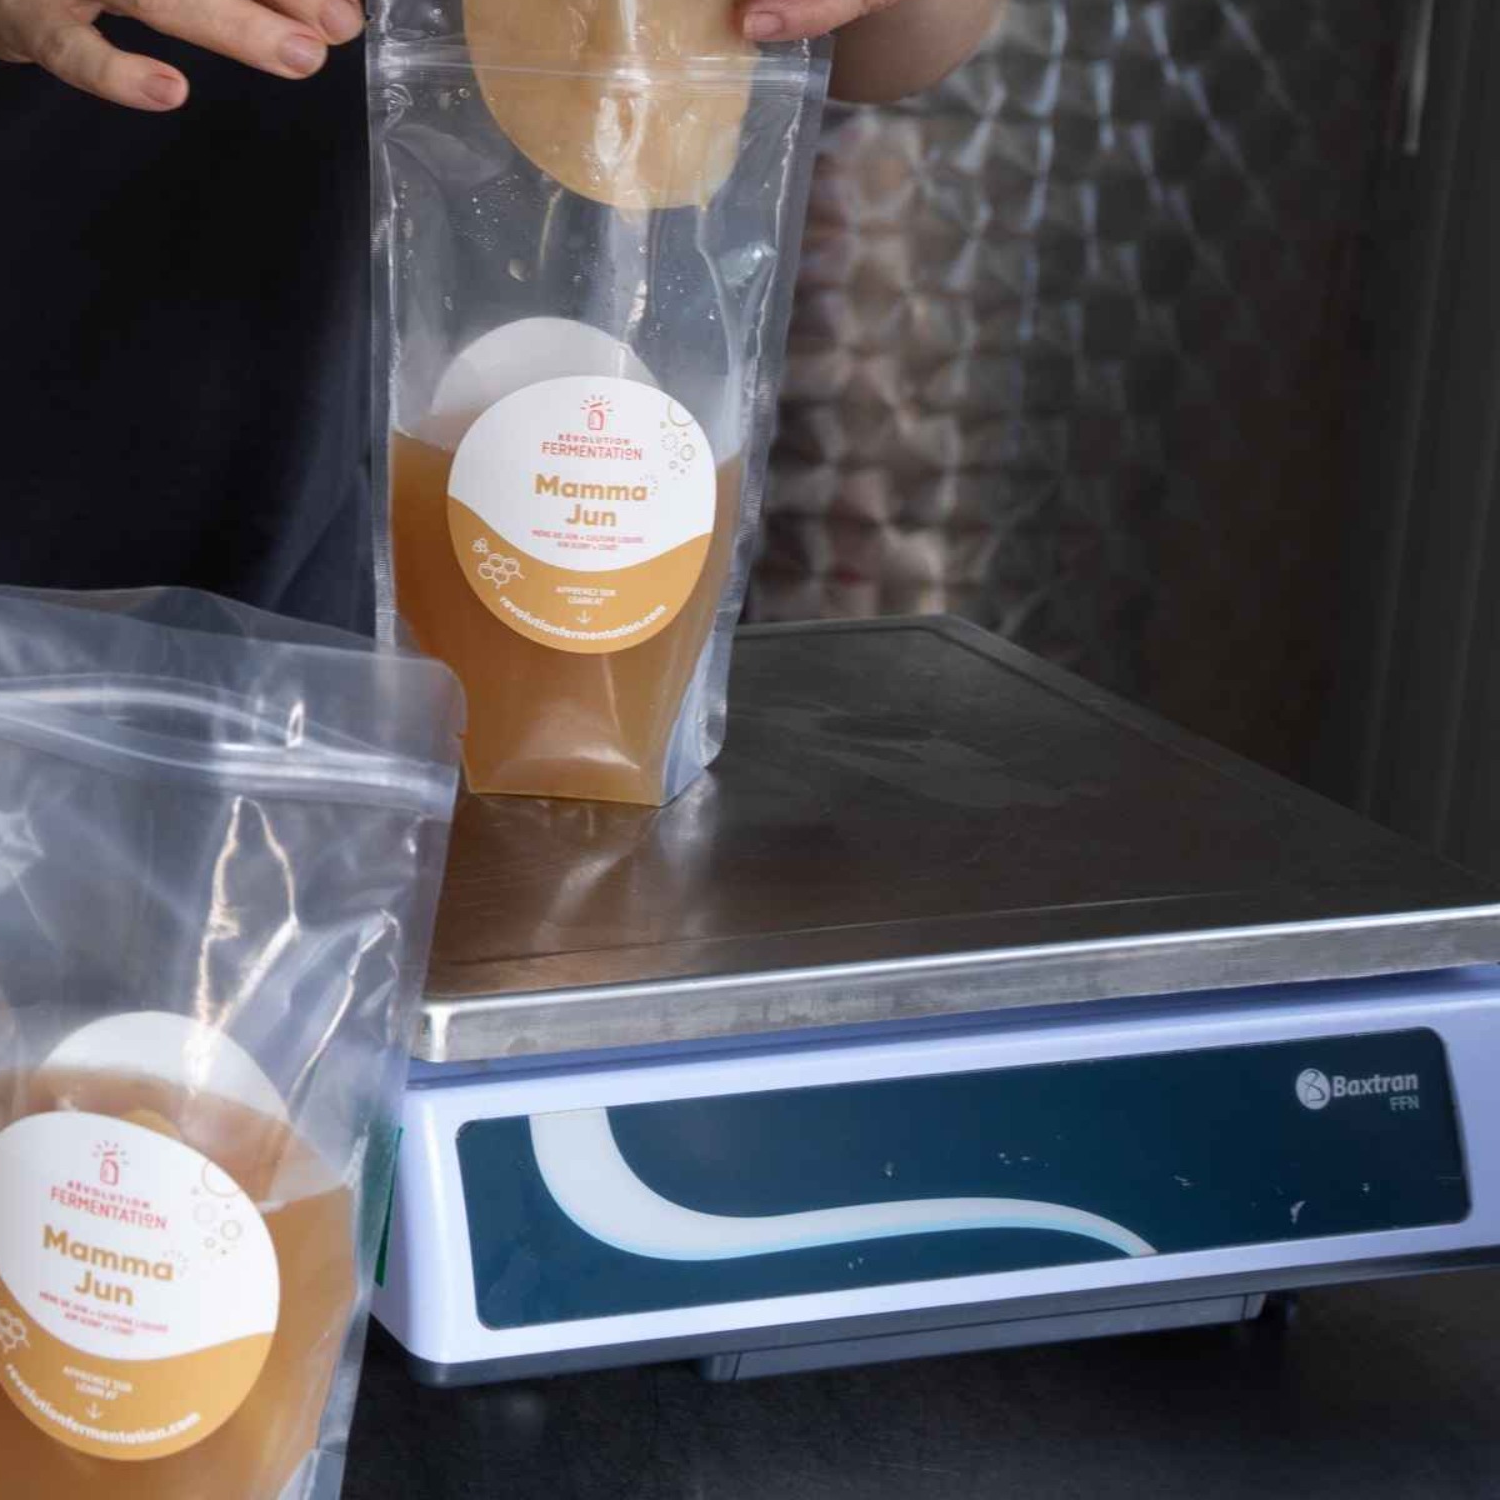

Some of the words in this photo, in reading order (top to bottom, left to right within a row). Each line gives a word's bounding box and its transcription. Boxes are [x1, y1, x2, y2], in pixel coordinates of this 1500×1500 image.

[541, 441, 643, 461] FERMENTATION
[534, 473, 648, 501] Mamma
[565, 503, 617, 527] Jun
[1332, 1073, 1419, 1097] Baxtran
[1389, 1095, 1420, 1111] FFN
[51, 1186, 168, 1229] FERMENTATION
[42, 1223, 175, 1282] Mamma
[75, 1271, 135, 1307] Jun
